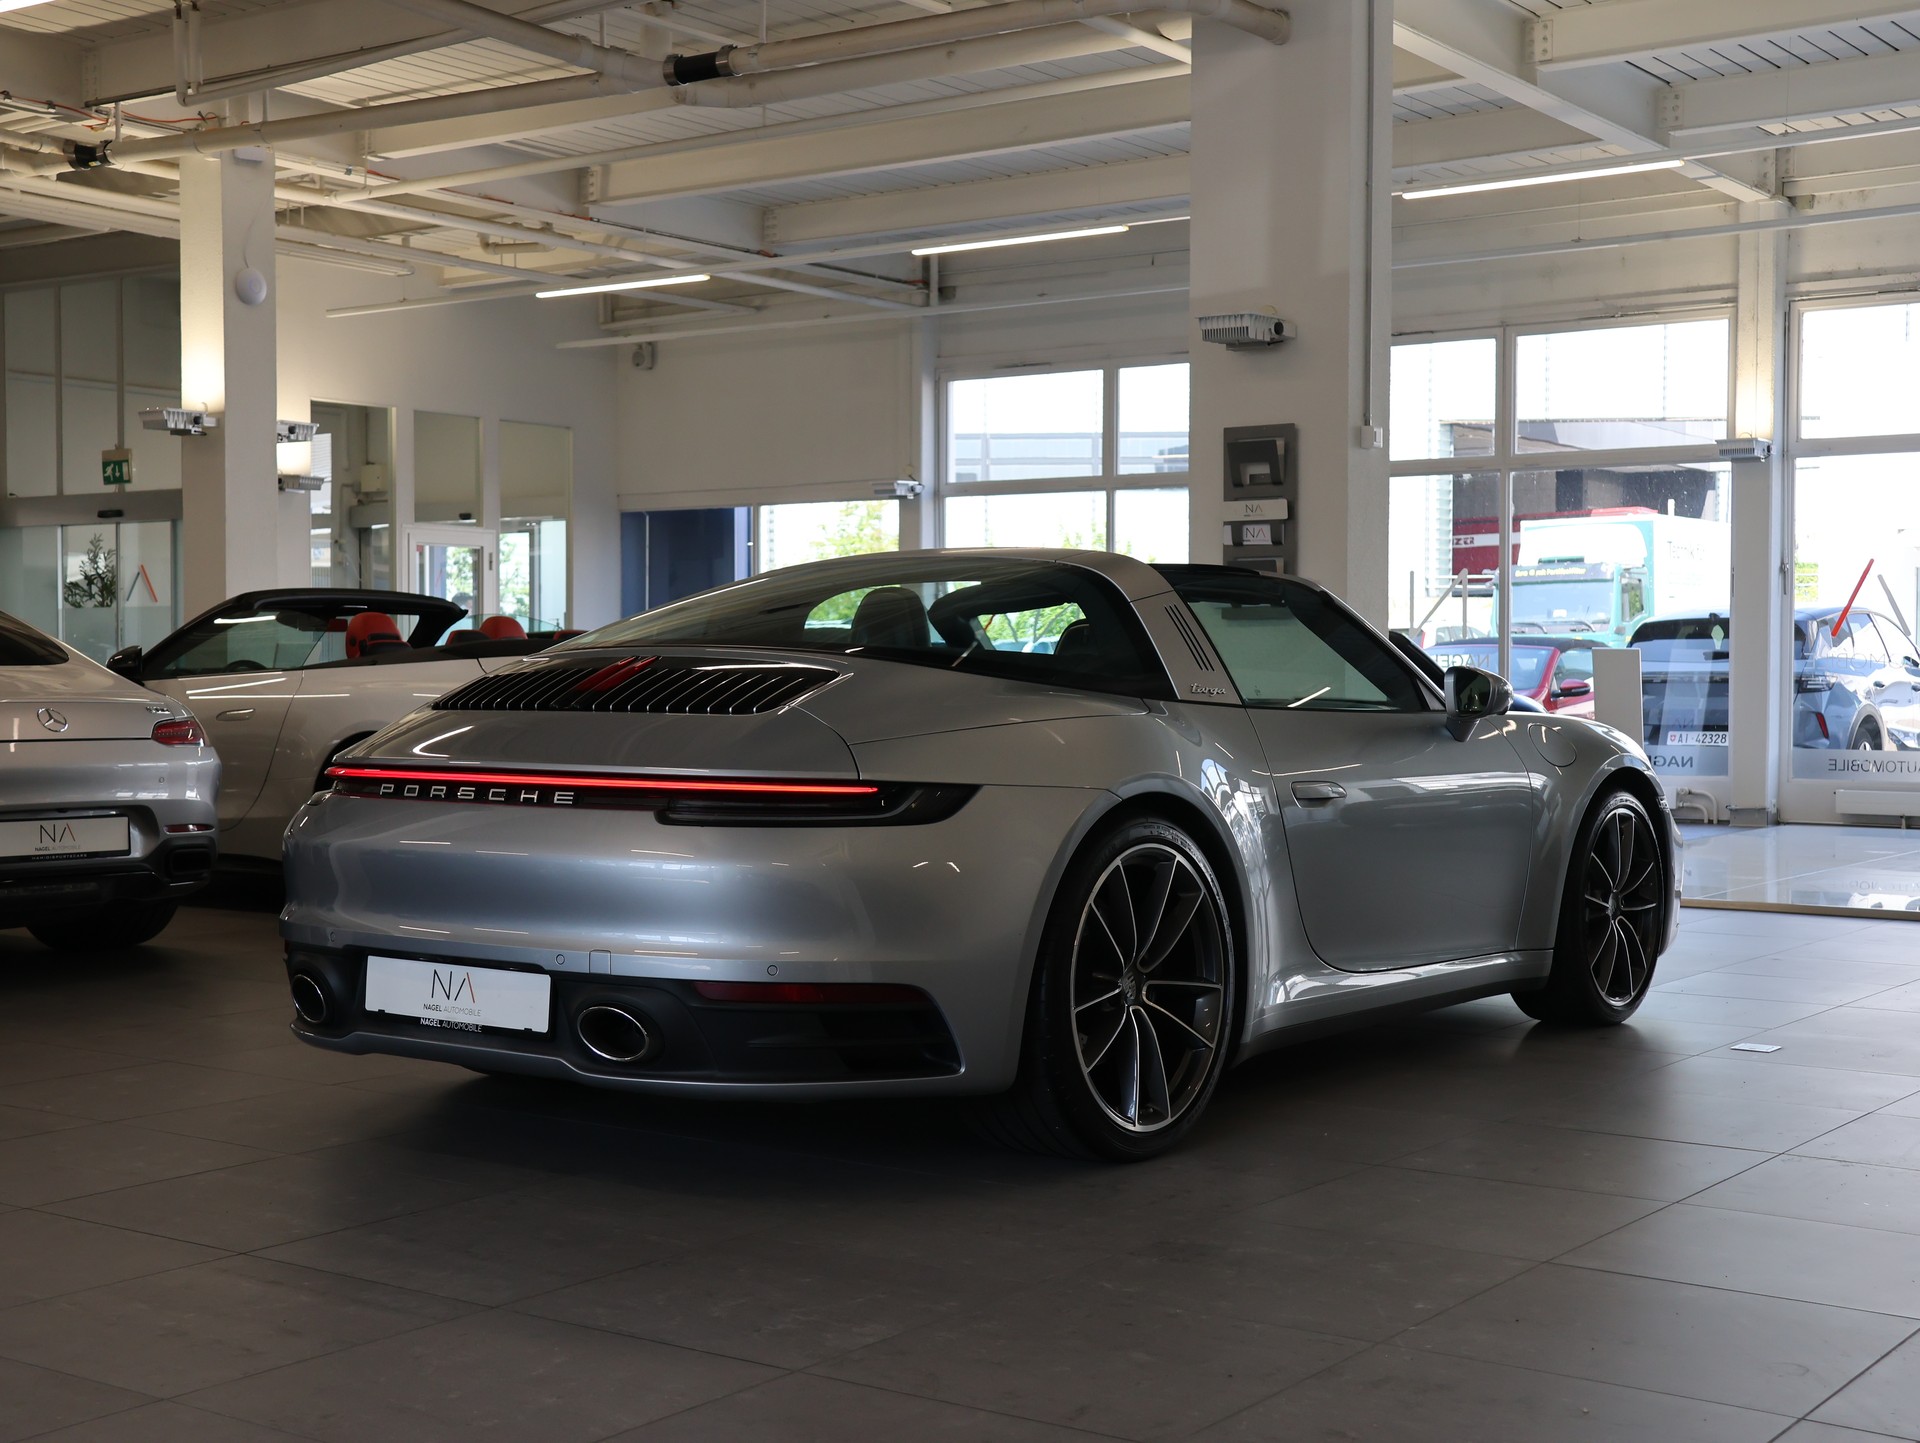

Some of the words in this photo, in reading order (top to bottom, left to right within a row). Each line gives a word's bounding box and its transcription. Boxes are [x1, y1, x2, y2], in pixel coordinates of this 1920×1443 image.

[1244, 503, 1263, 513] NA
[1245, 527, 1267, 538] NA
[1190, 683, 1226, 697] targa
[1695, 733, 1727, 744] 42328
[379, 783, 575, 805] PORSCHE
[39, 822, 76, 844] NA
[431, 968, 476, 1003] NA
[423, 1003, 442, 1012] NAGEL
[443, 1006, 482, 1017] AUTOMOBILE
[420, 1017, 441, 1027] NAGEL
[442, 1020, 482, 1033] AUTOMOBILE
